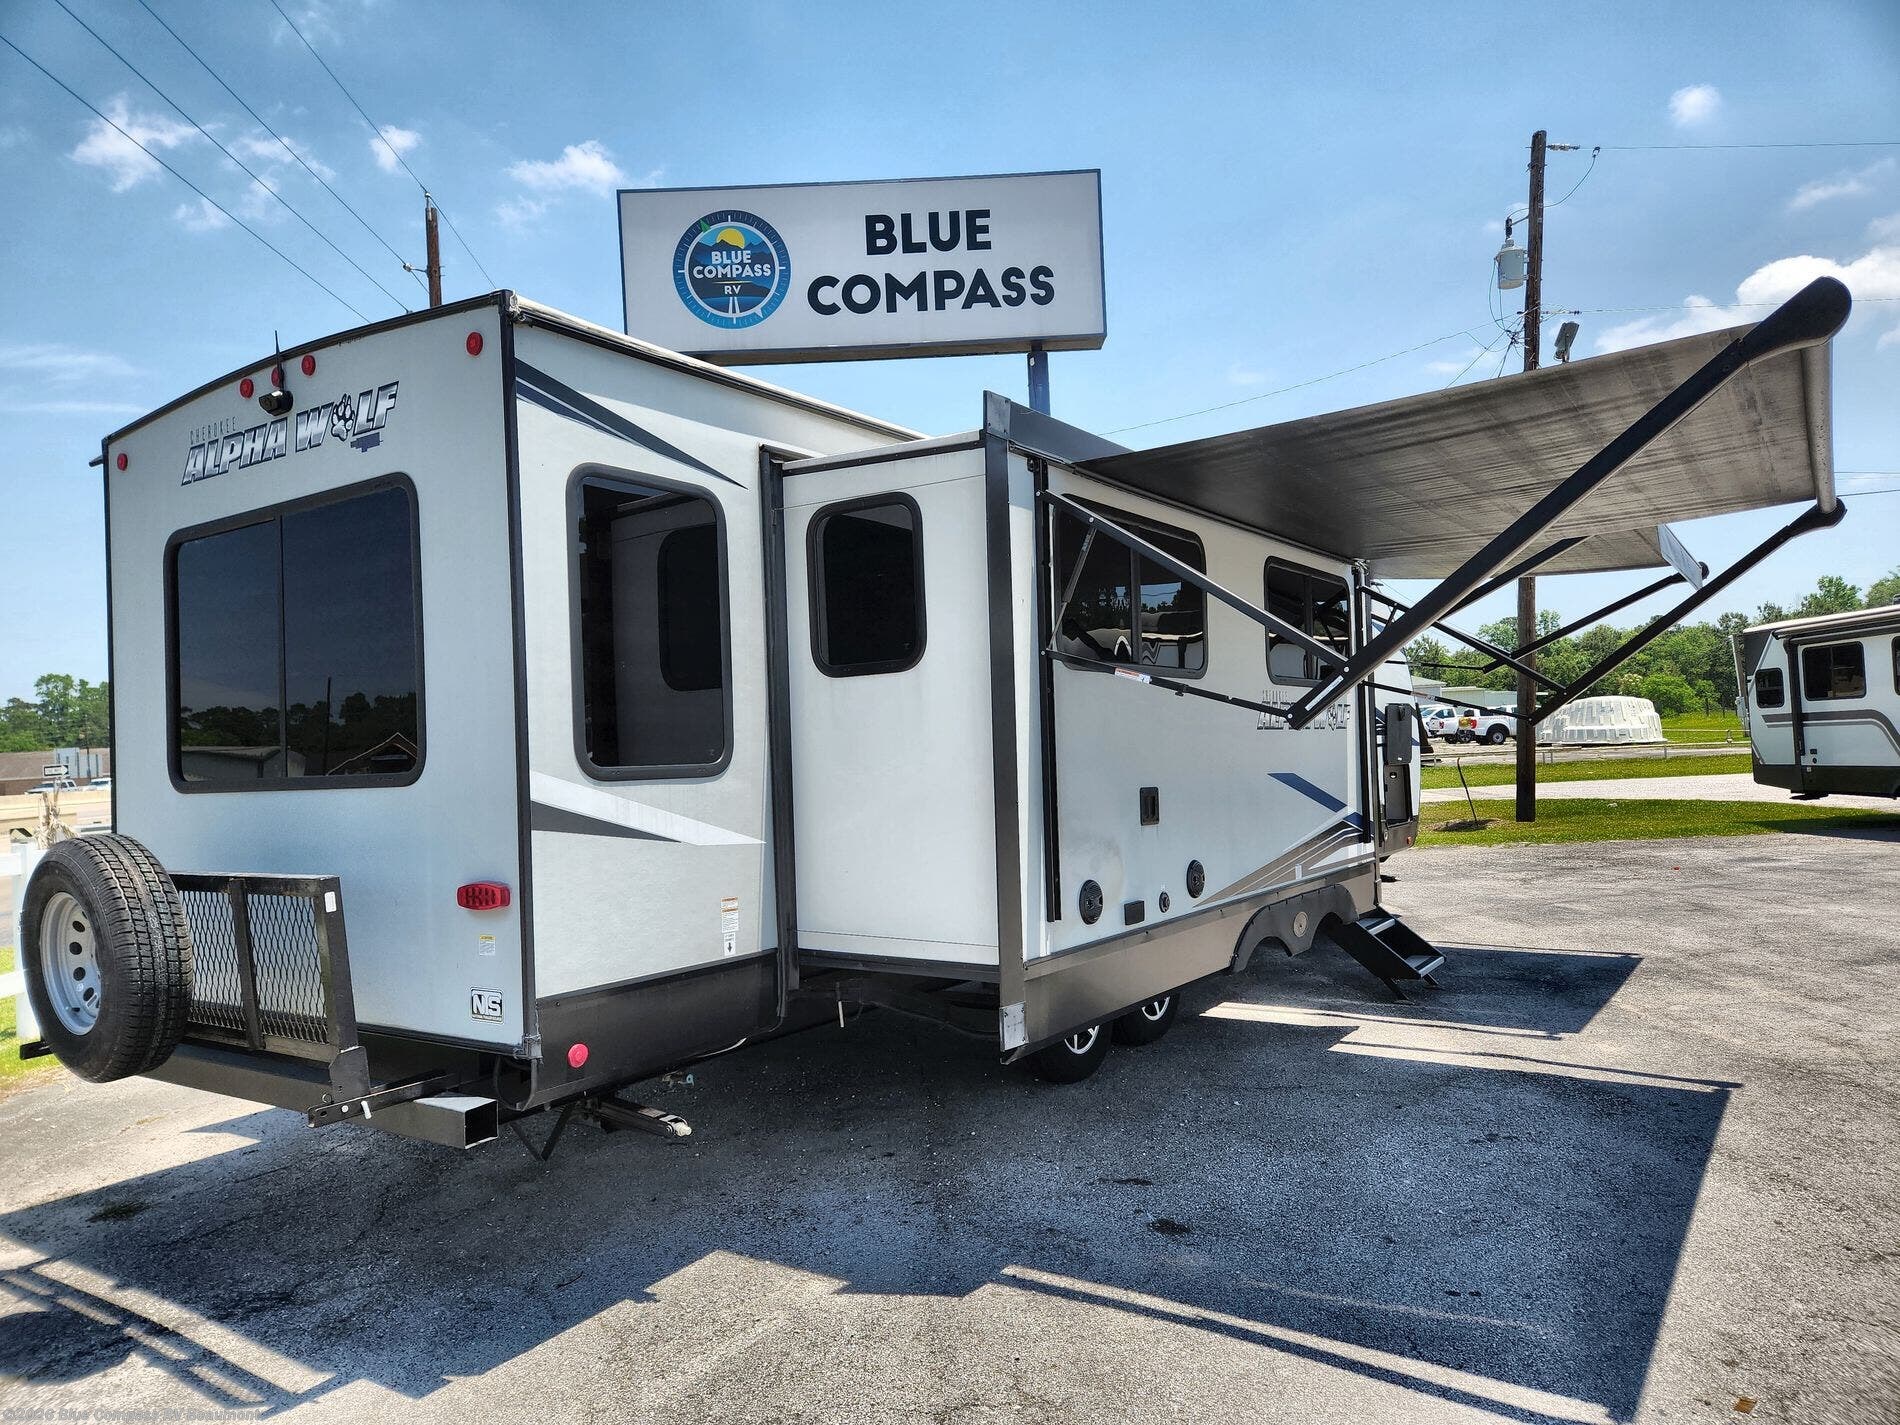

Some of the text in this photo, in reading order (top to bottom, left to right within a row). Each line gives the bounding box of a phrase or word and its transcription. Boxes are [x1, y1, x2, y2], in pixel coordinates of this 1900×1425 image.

[865, 209, 992, 256] BLUE
[693, 264, 771, 279] COMPASS
[711, 250, 752, 265] BLUE
[724, 285, 741, 295] RV
[807, 265, 1055, 316] COMPASS
[181, 416, 288, 486] ALPHA
